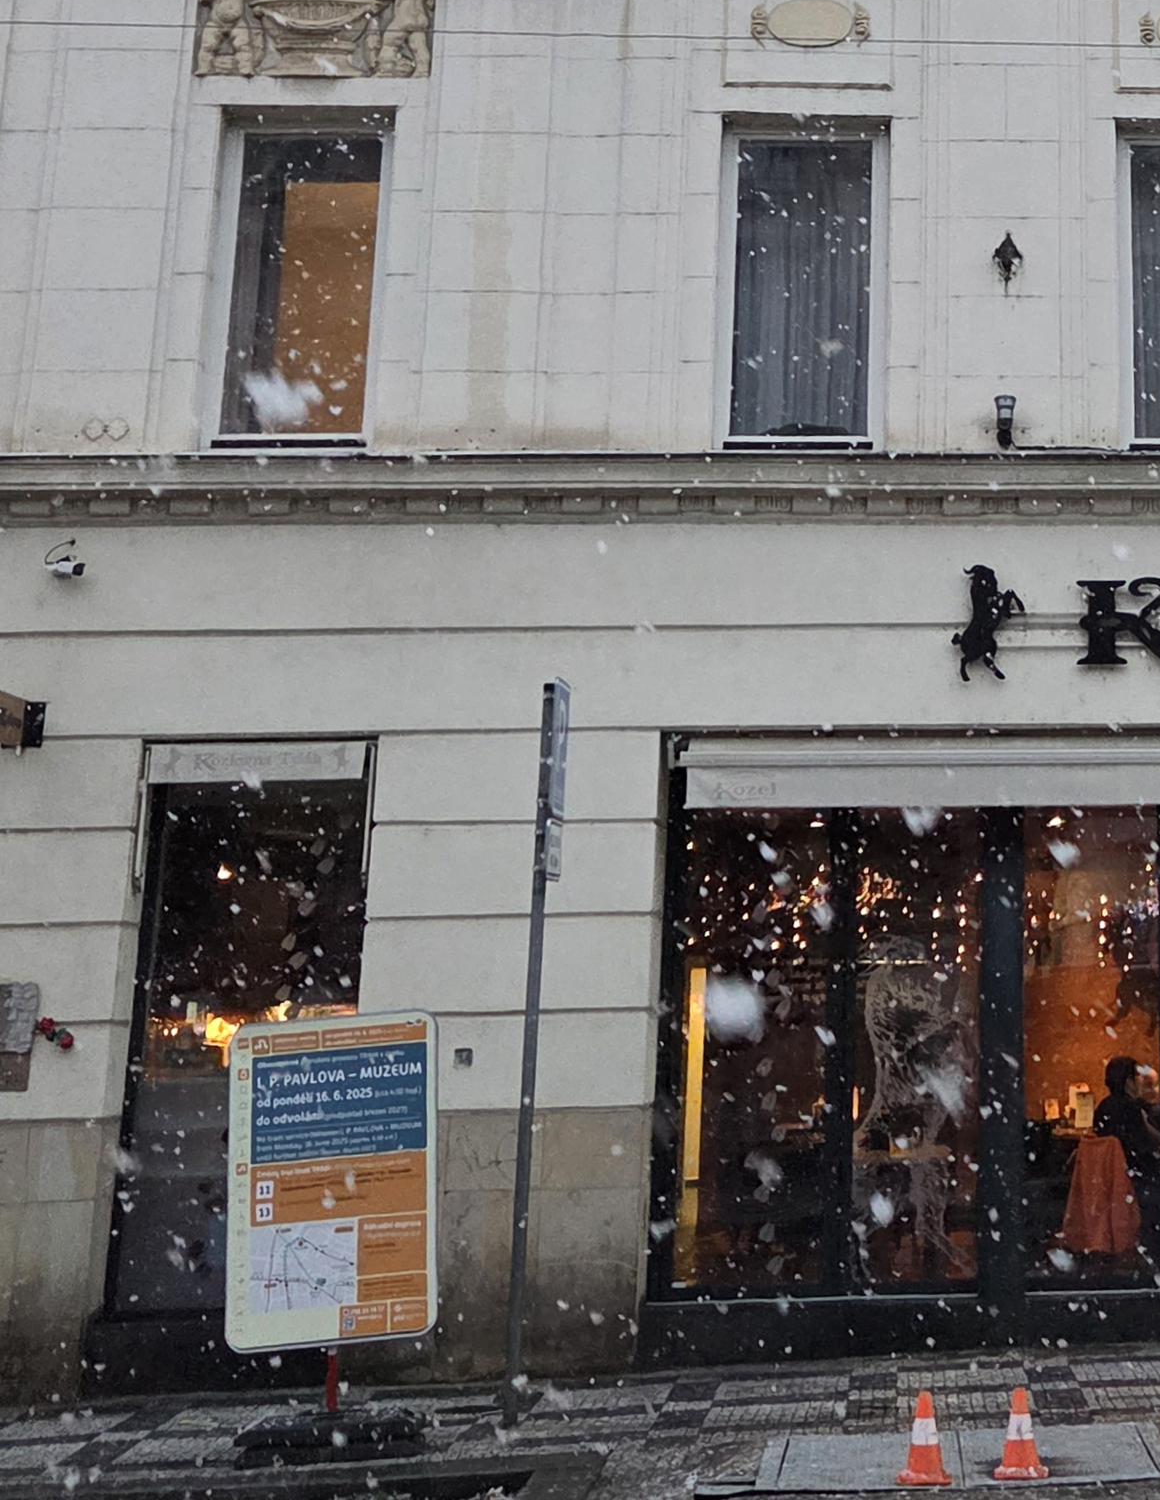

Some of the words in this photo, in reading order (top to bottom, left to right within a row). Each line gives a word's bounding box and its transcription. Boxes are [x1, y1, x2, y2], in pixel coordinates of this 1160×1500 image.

[712, 782, 777, 801] Kozel
[283, 1069, 346, 1088] PAVLOVA
[359, 1062, 422, 1080] MUZEUM
[256, 1093, 271, 1108] od
[272, 1090, 313, 1110] pondělí
[315, 1090, 331, 1103] 16.
[333, 1091, 344, 1101] 6.
[346, 1086, 373, 1100] 2025
[256, 1114, 270, 1127] do
